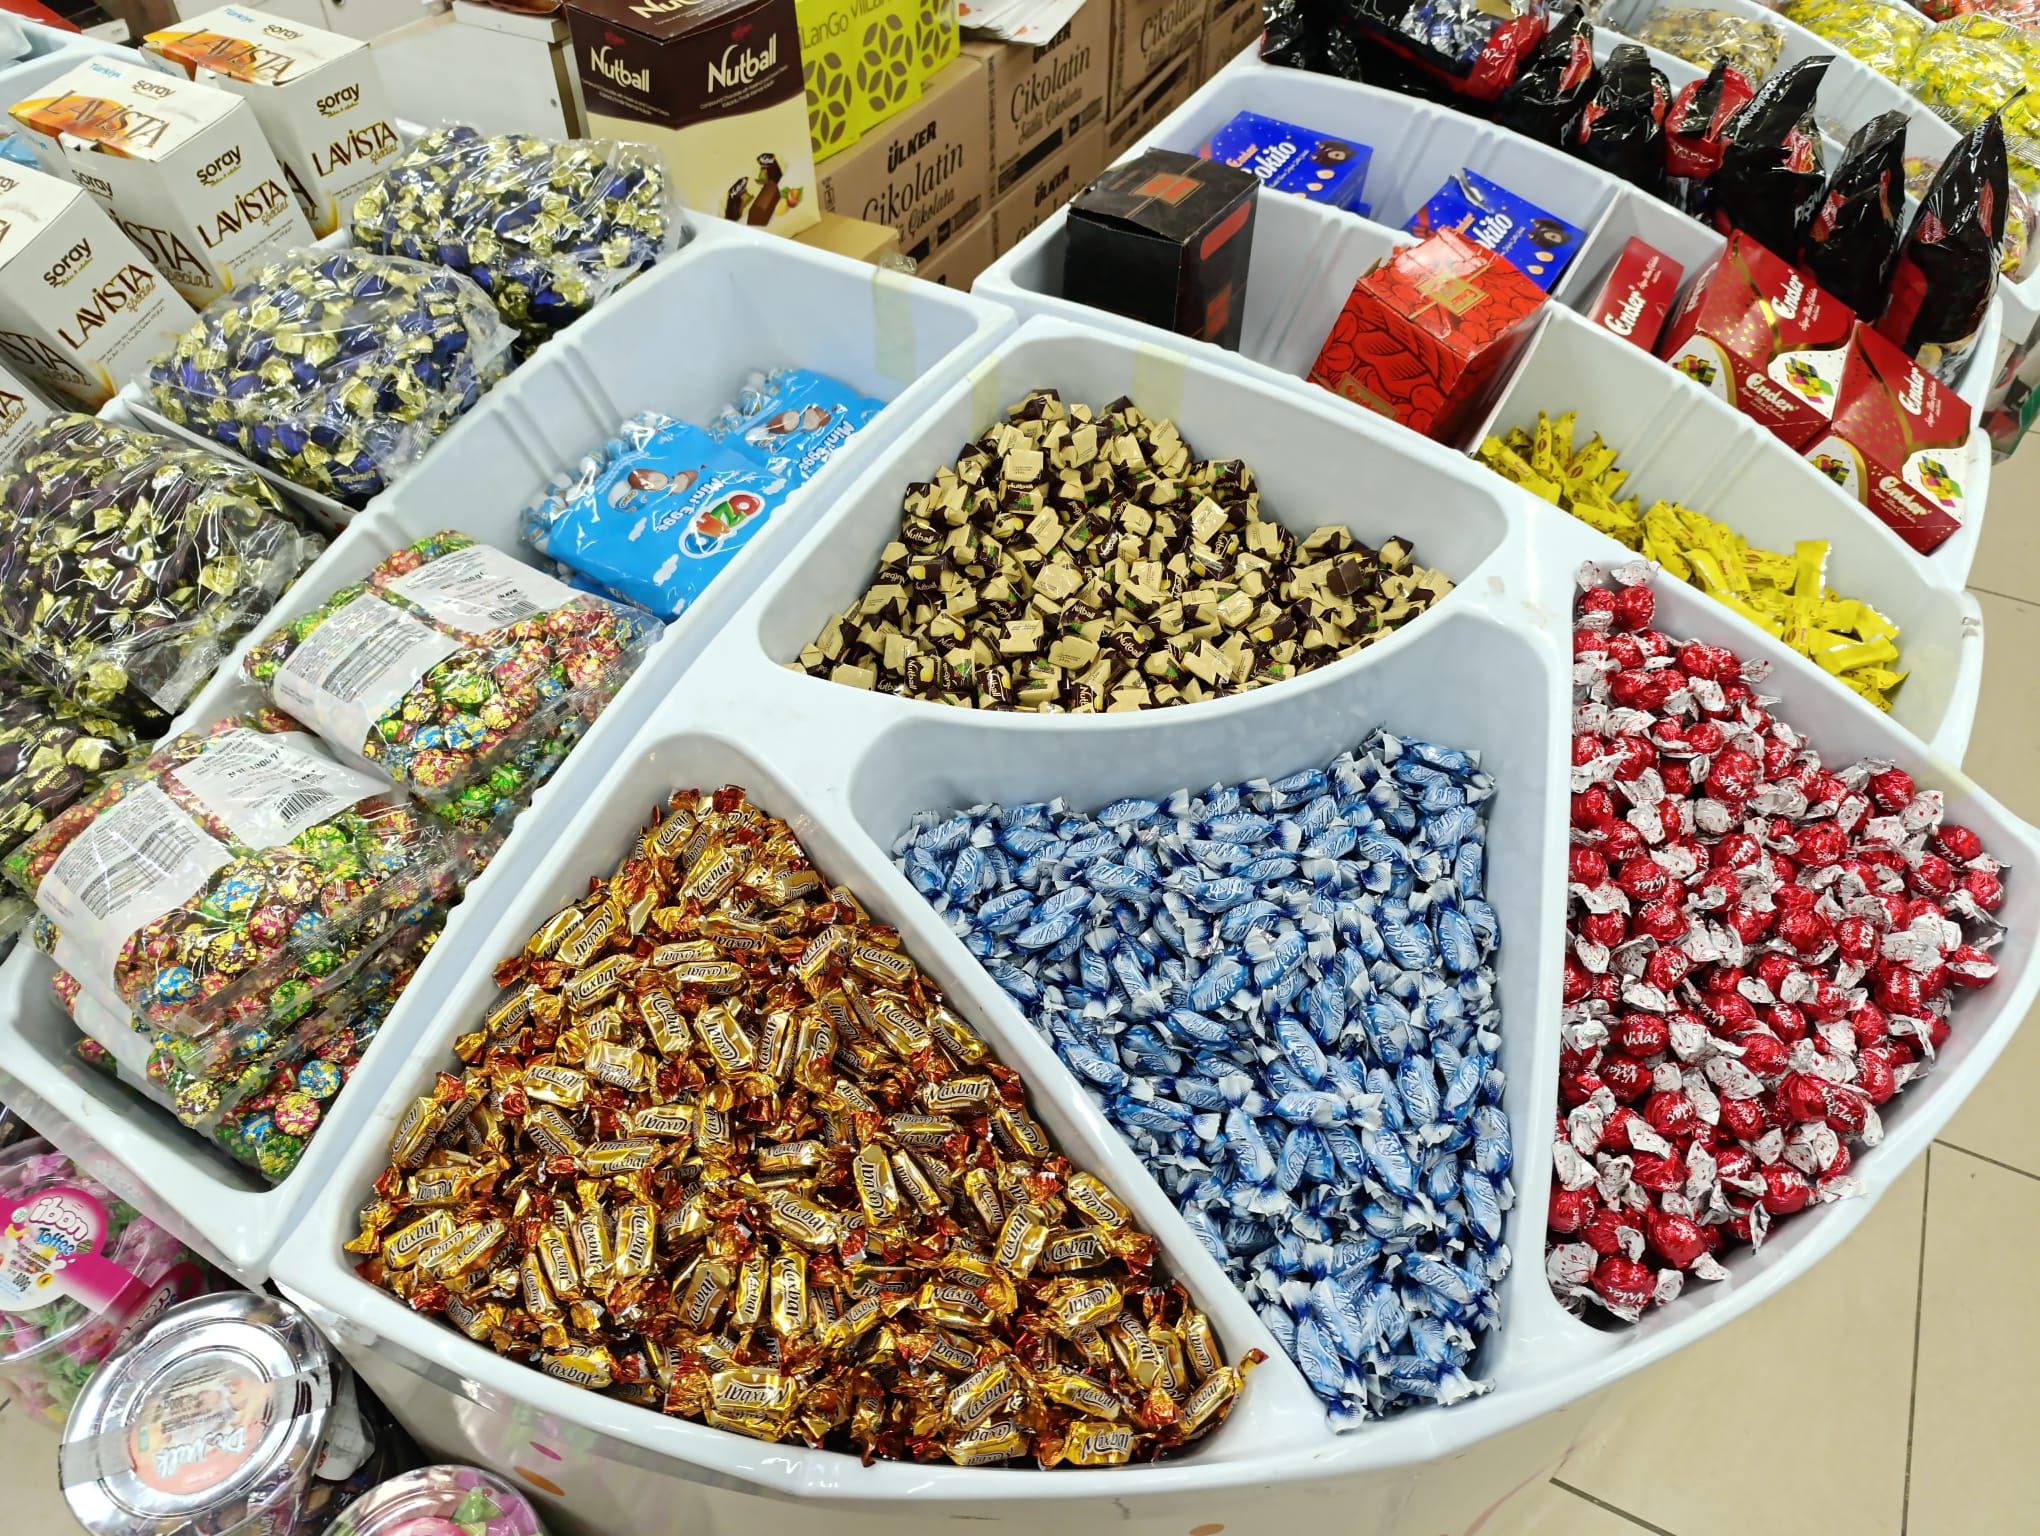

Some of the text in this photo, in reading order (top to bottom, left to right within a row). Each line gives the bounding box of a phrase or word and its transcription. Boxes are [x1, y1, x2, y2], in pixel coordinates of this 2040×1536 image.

[590, 46, 650, 93] Nutball
[708, 33, 777, 94] Nutball
[1010, 45, 1091, 130] Çikolatin
[887, 121, 937, 174] ÜLKER
[1604, 287, 1647, 336] Ender
[1771, 274, 1805, 320] Ender
[1746, 373, 1796, 411] Ender
[1899, 366, 1926, 416] Ender
[1879, 476, 1929, 516] Ender
[903, 527, 937, 546] Nutball
[1072, 603, 1097, 621] Nutball
[1115, 632, 1147, 659] Nutball
[908, 658, 918, 691] Nutball
[1359, 837, 1395, 864] Wish
[1099, 864, 1138, 887] Wish
[574, 907, 614, 961] Maxbar
[1031, 920, 1069, 944] Wish
[855, 945, 912, 973] Maxbar
[1265, 945, 1299, 980] Wish
[570, 961, 624, 1006] Maxbar
[1201, 973, 1237, 1006] Wish
[644, 990, 685, 1039] Maxbar
[876, 1003, 932, 1040] Maxbar
[701, 1017, 753, 1070] Maxbar
[759, 1018, 778, 1078] Maxbar
[528, 1065, 585, 1088] Maxbar
[927, 1080, 988, 1104] Maxbar
[636, 1115, 695, 1134] Maxbar
[599, 1155, 651, 1176] Maxbar
[858, 1155, 896, 1221] Maxbar
[29, 1196, 89, 1241] ibon
[771, 1190, 836, 1235] Maxbar
[974, 1181, 1005, 1225] Maxbar
[36, 1227, 76, 1256] Toffee
[388, 1213, 445, 1267] Maxbar
[457, 1220, 498, 1267] Maxbar
[629, 1205, 652, 1271] Maxbar
[999, 1207, 1031, 1272] Maxbar
[1041, 1240, 1101, 1273] Maxbar
[544, 1236, 573, 1289] Maxbar
[522, 1267, 542, 1308] Maxbar
[743, 1260, 763, 1321] Maxbar
[773, 1256, 801, 1329] Maxbar
[1118, 1312, 1161, 1366] Maxbar
[716, 1379, 791, 1408] Maxbar
[958, 1371, 1012, 1425] Maxbar
[1071, 1386, 1119, 1410] Maxbar
[1185, 1377, 1222, 1426] Maxbar
[1082, 1433, 1135, 1461] Maxbar
